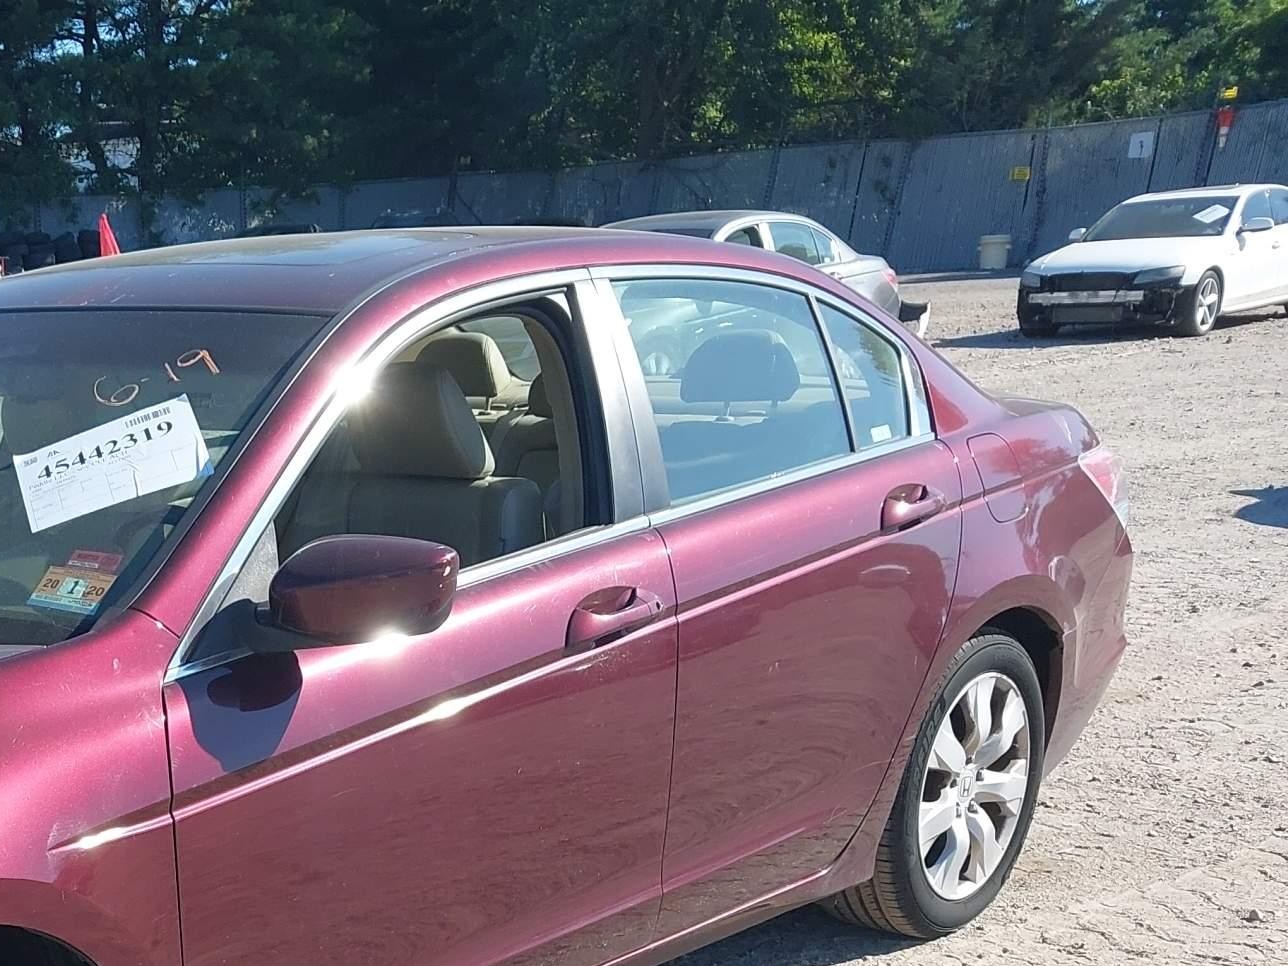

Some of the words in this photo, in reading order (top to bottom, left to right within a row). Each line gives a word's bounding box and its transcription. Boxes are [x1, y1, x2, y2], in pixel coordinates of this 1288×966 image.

[36, 420, 174, 481] 45442319
[43, 578, 60, 589] 20
[67, 580, 79, 594] 1
[87, 585, 105, 597] 20
